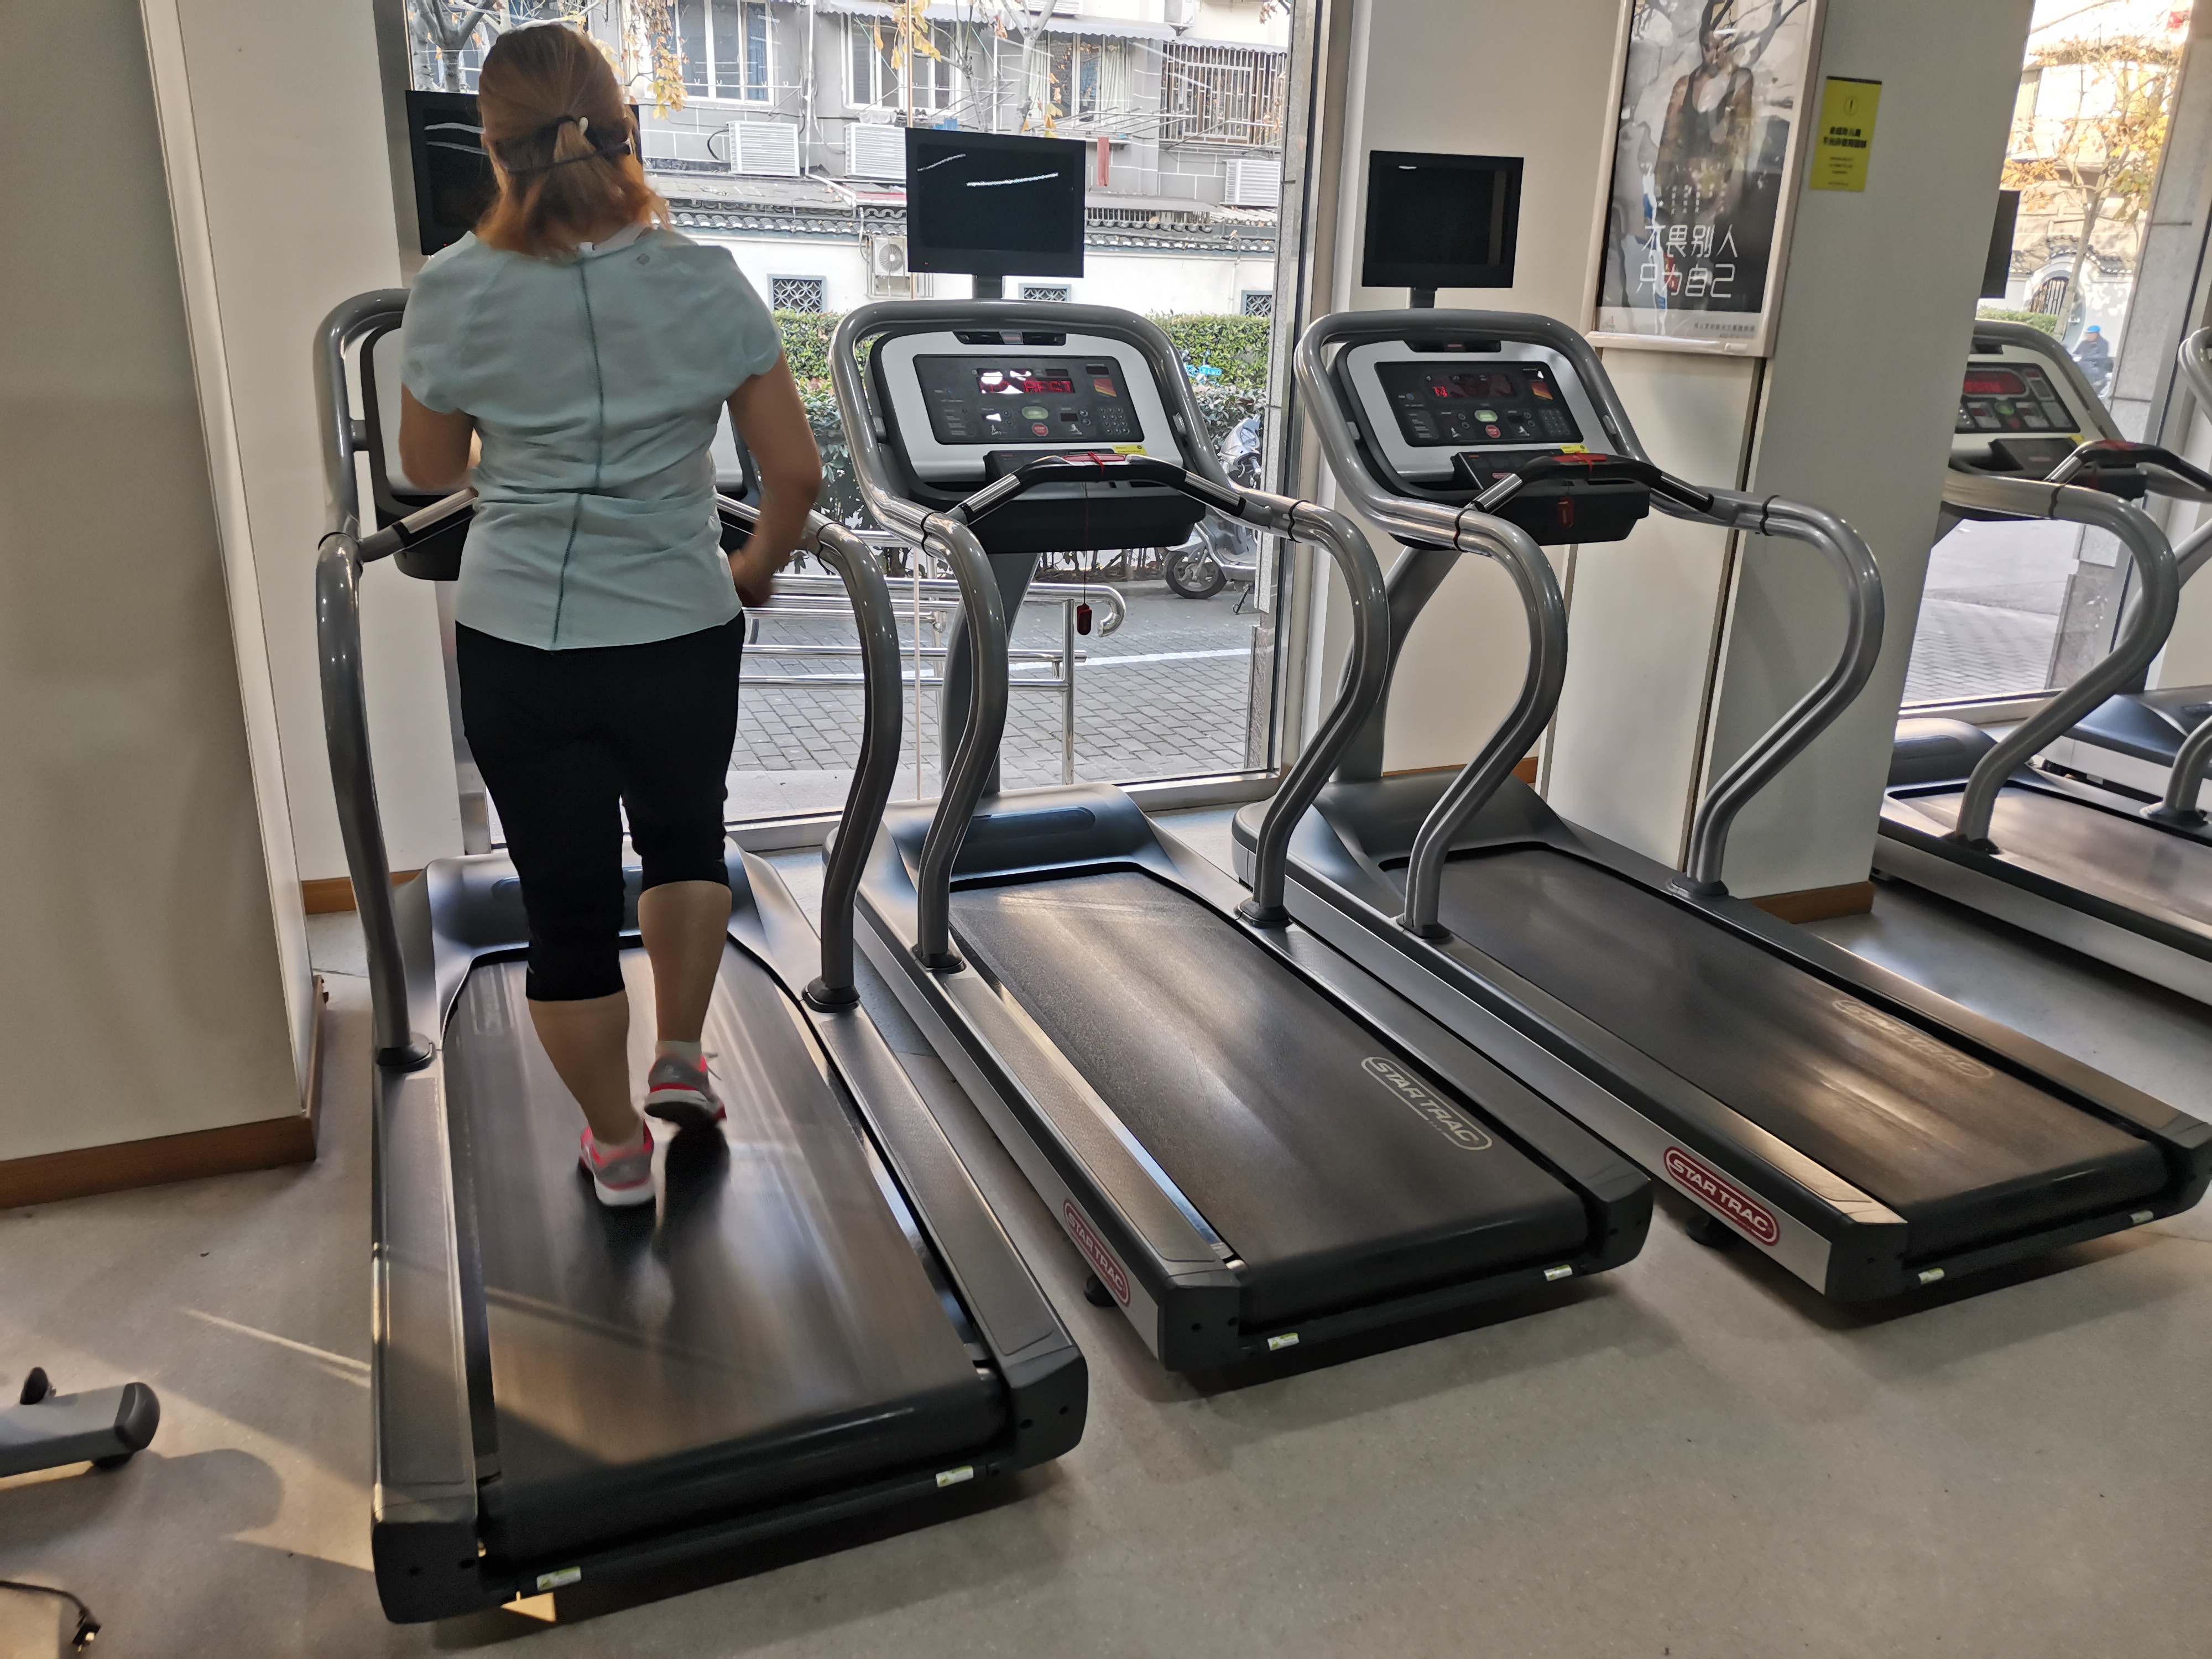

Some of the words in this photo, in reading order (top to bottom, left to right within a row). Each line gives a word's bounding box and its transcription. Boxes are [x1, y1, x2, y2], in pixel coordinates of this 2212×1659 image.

[1642, 224, 1738, 258] 不畏别人
[1636, 262, 1735, 298] 只为自己
[1368, 1058, 1426, 1098] STAR
[1420, 1099, 1480, 1141] TRAC
[1668, 1159, 1717, 1196] STAR
[1719, 1190, 1768, 1232] TRAC
[1067, 1212, 1093, 1253] STAR
[1094, 1246, 1124, 1291] TRAC
